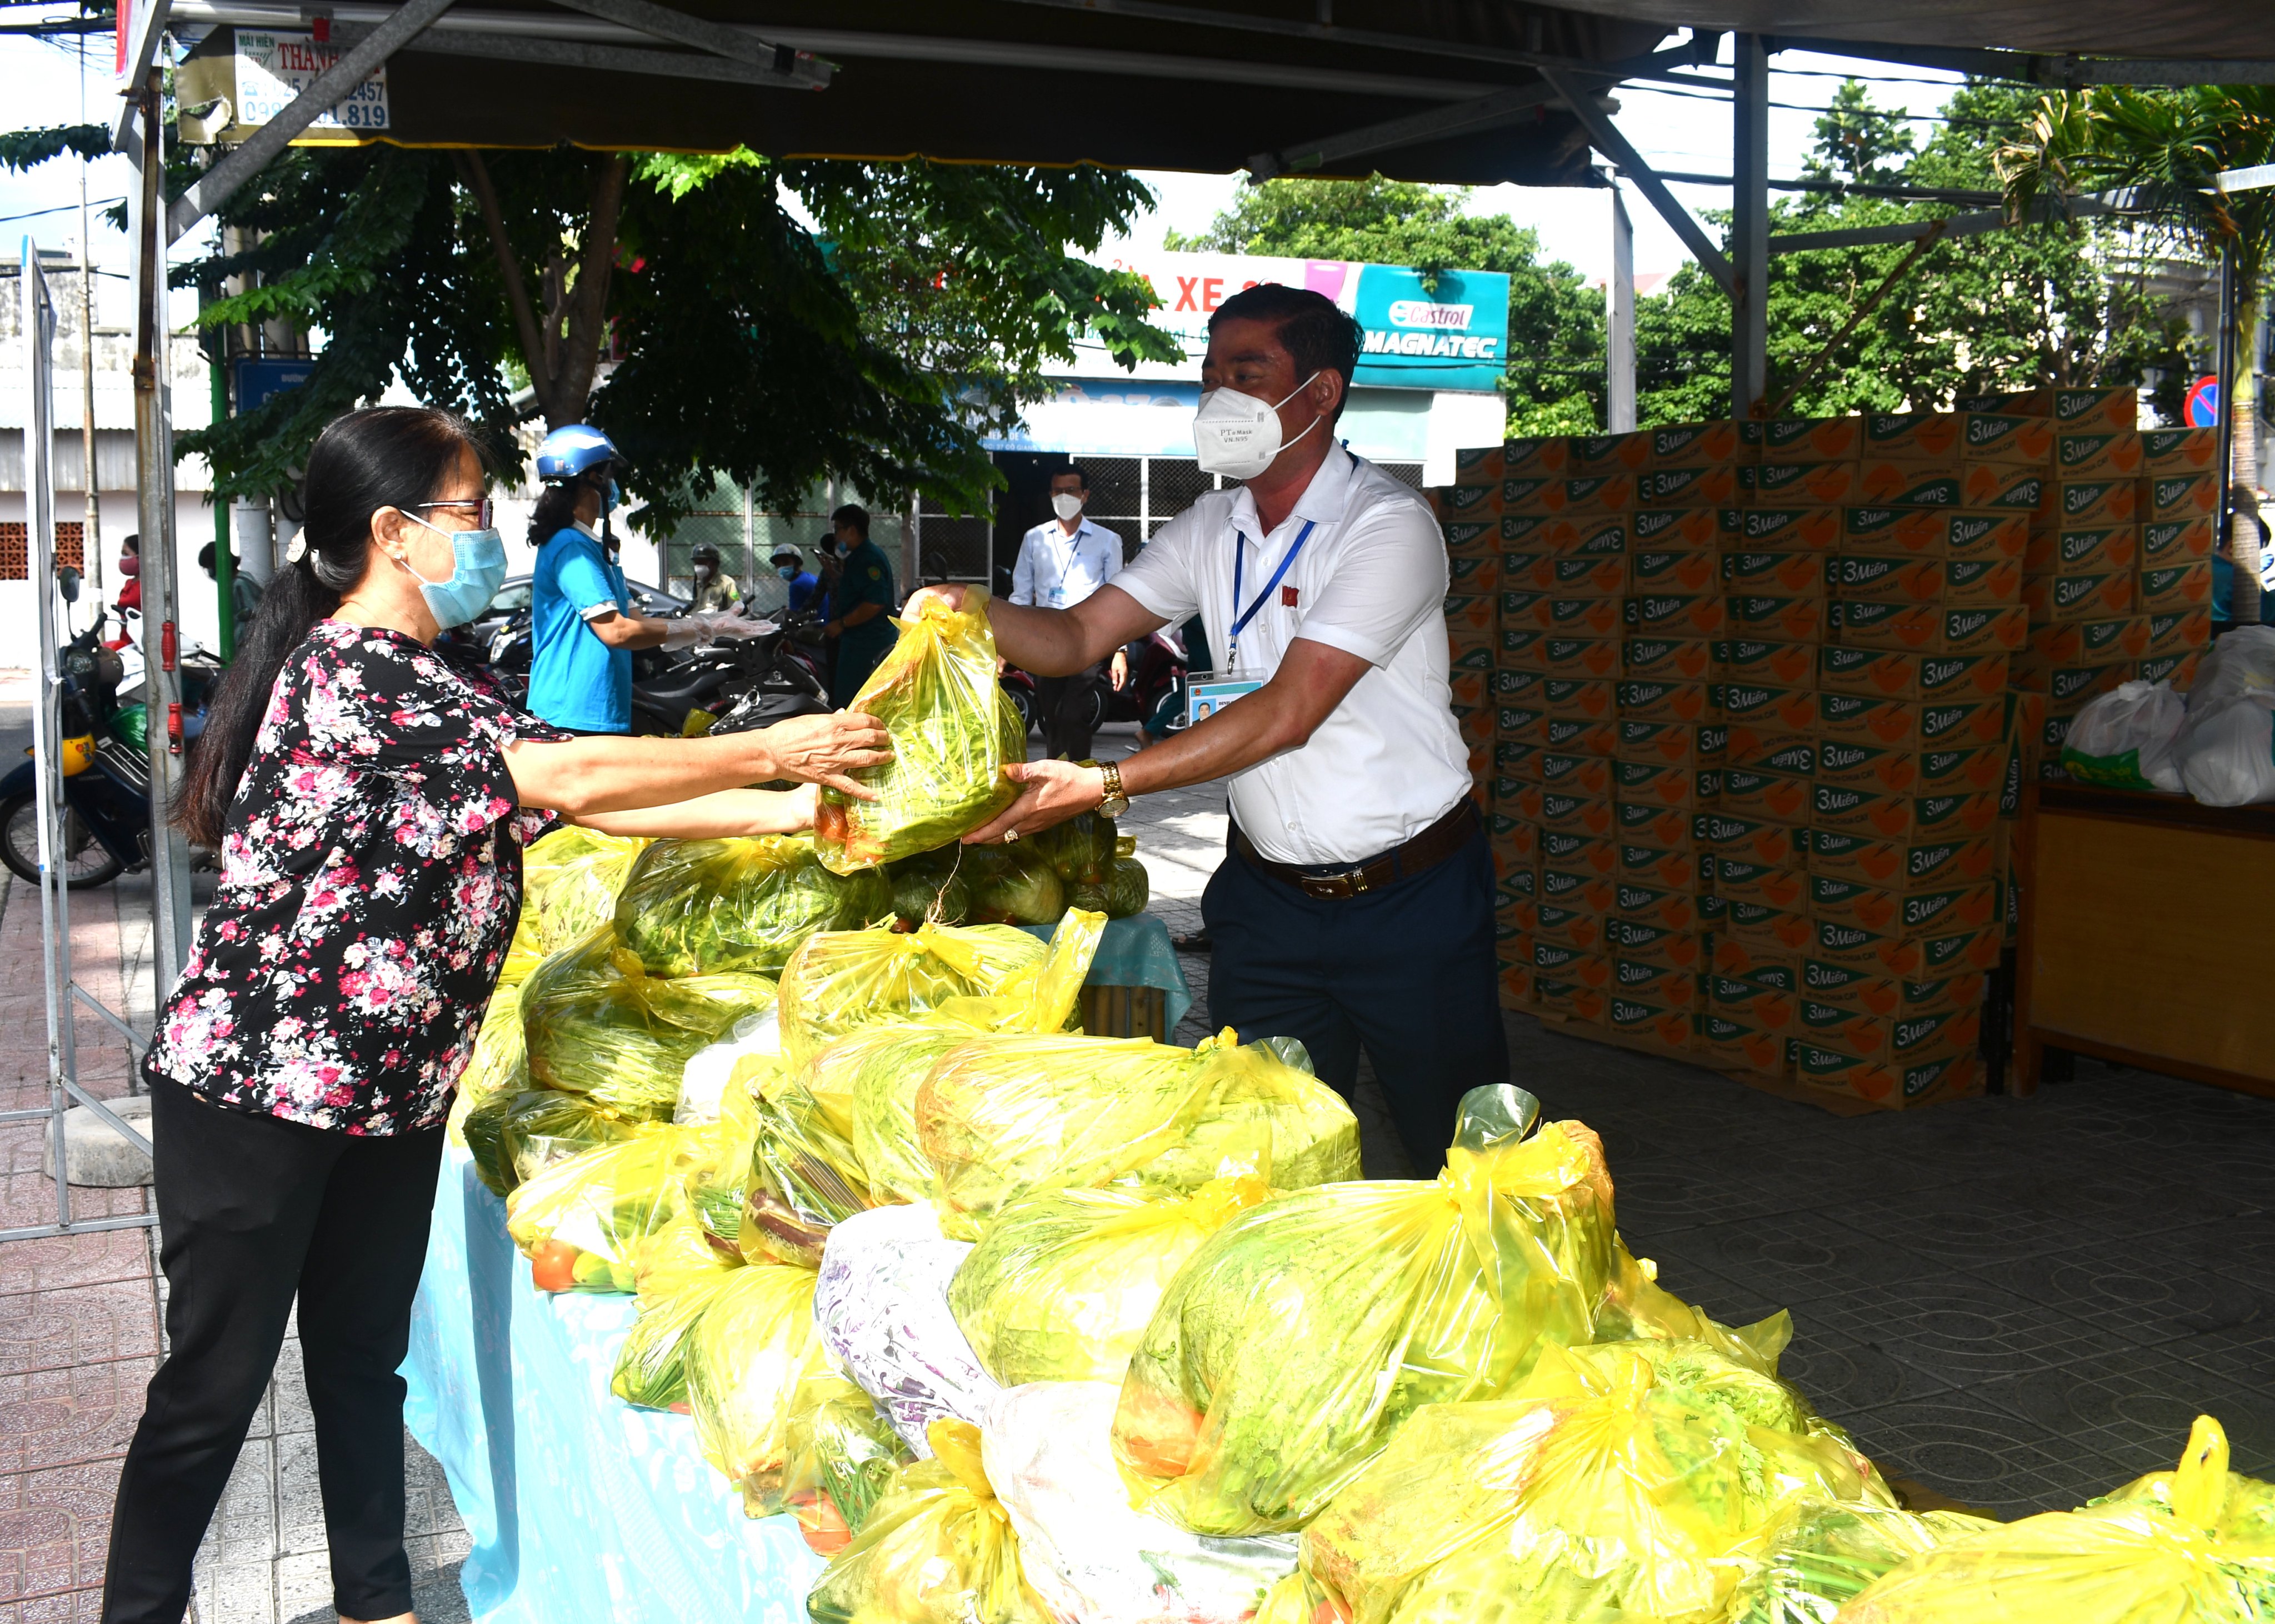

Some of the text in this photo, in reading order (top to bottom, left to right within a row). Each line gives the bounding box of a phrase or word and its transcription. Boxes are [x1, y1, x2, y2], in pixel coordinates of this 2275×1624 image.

[238, 33, 274, 48] MÁI HIÊN
[1174, 276, 1224, 312] XE
[1410, 305, 1466, 326] Castrol
[1362, 331, 1498, 358] MAGNATEC
